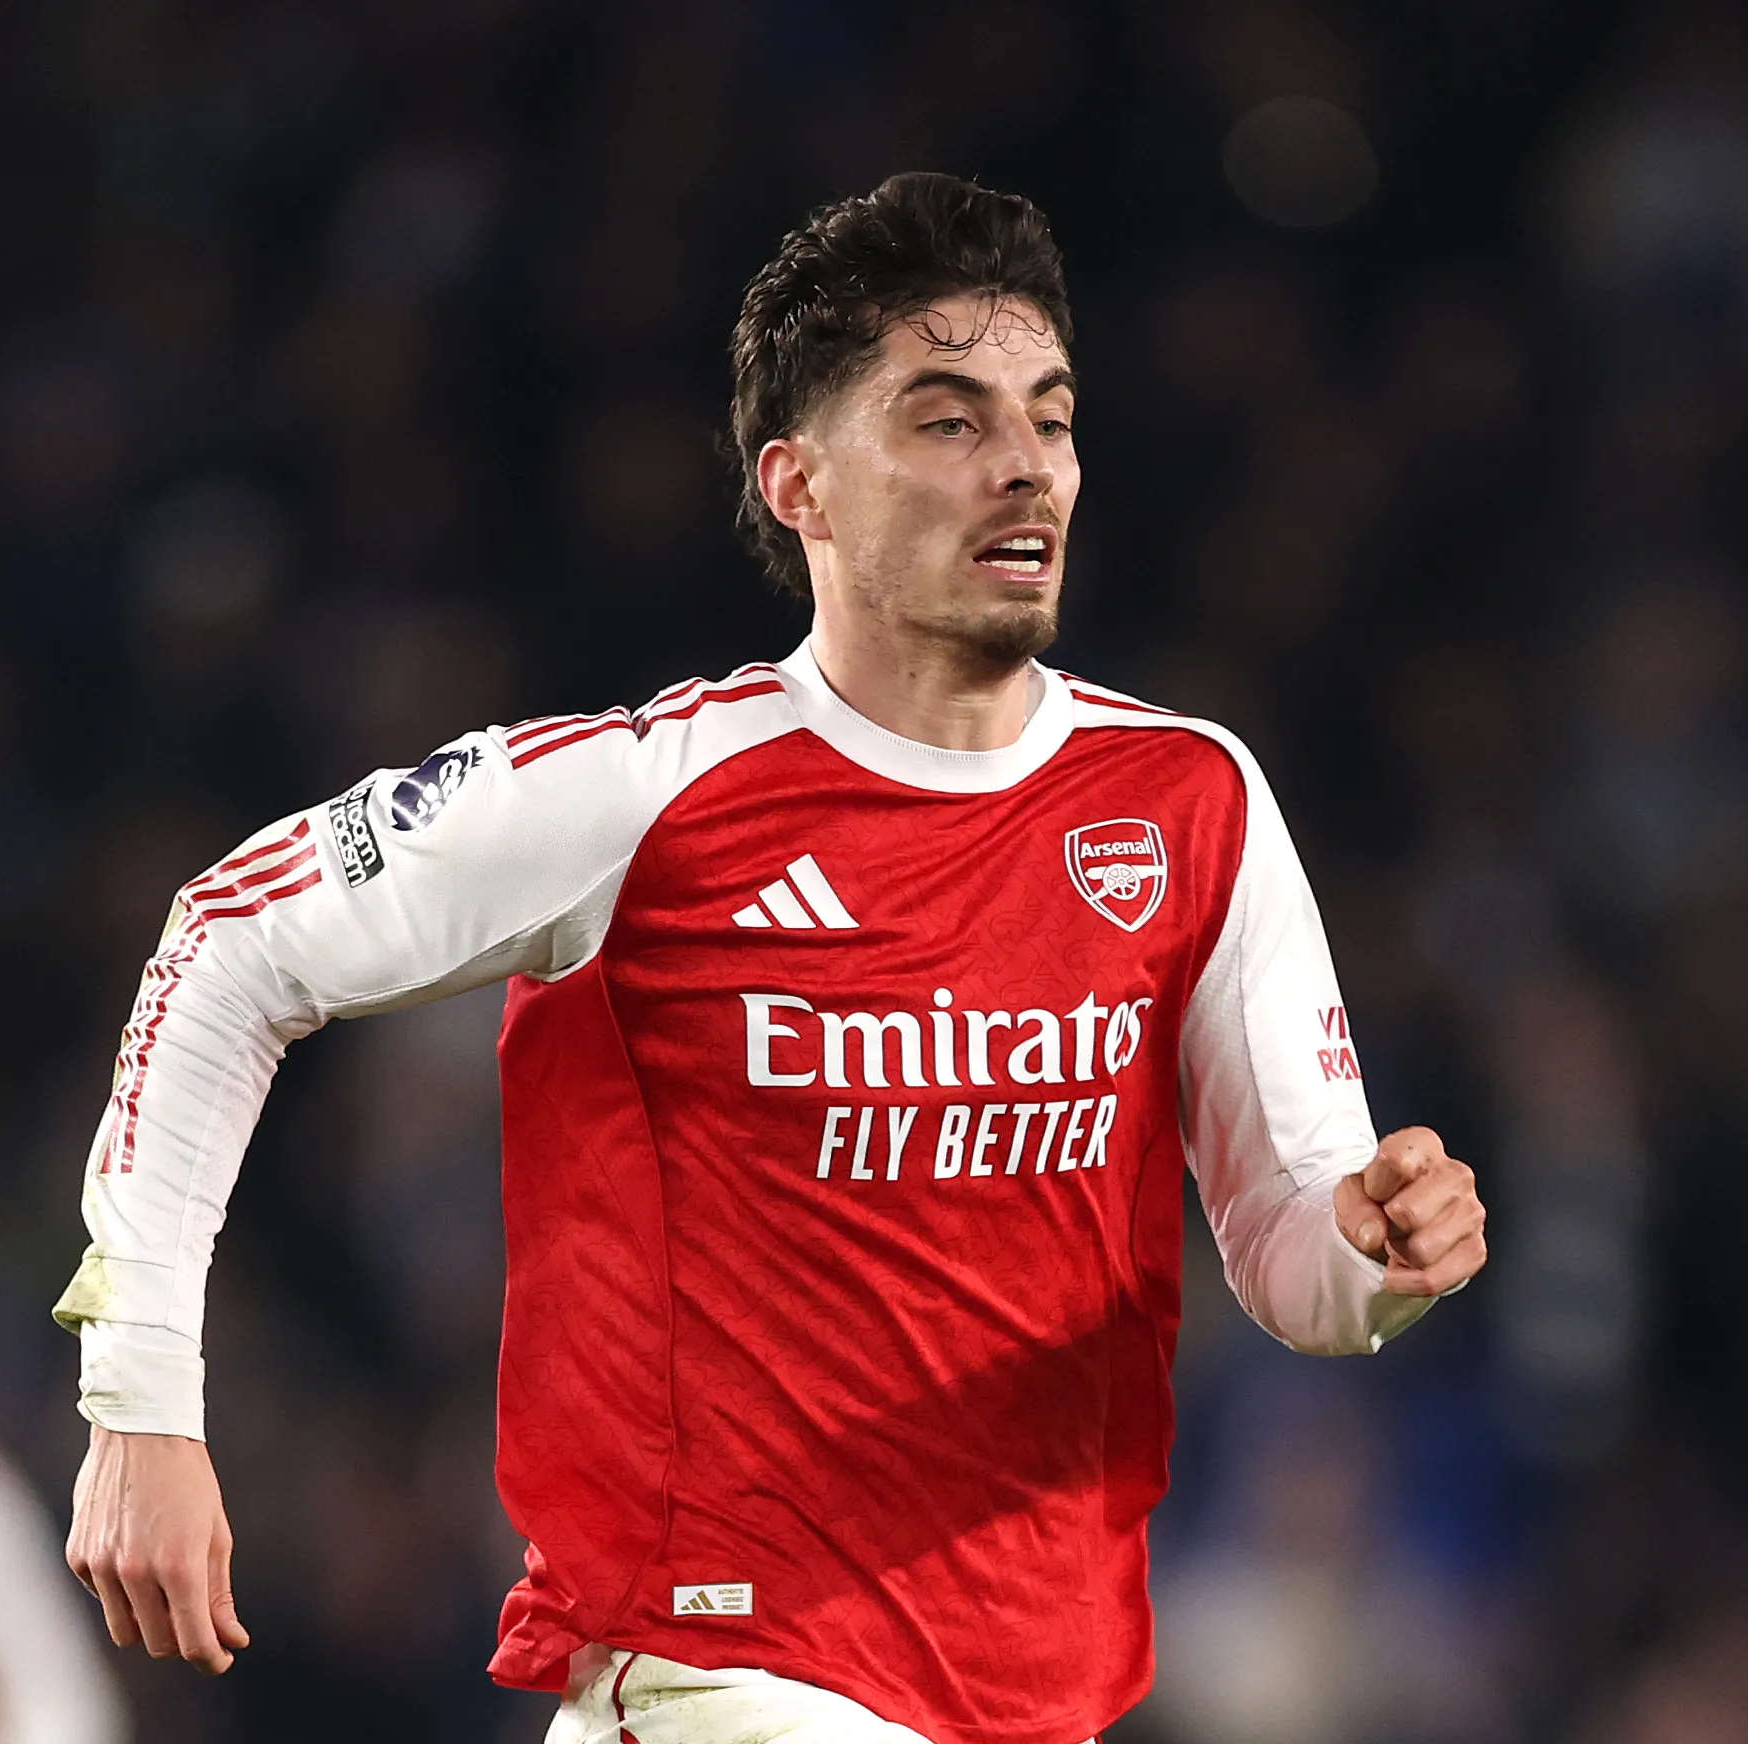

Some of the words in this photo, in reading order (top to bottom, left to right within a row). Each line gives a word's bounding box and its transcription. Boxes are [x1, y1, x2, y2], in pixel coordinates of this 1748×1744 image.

[330, 805, 367, 887] racism
[347, 798, 377, 867] room
[1080, 837, 1152, 859] Arsenal
[739, 987, 1153, 1089] Emirates
[816, 1105, 921, 1181] FLY
[933, 1094, 1118, 1180] BETTER
